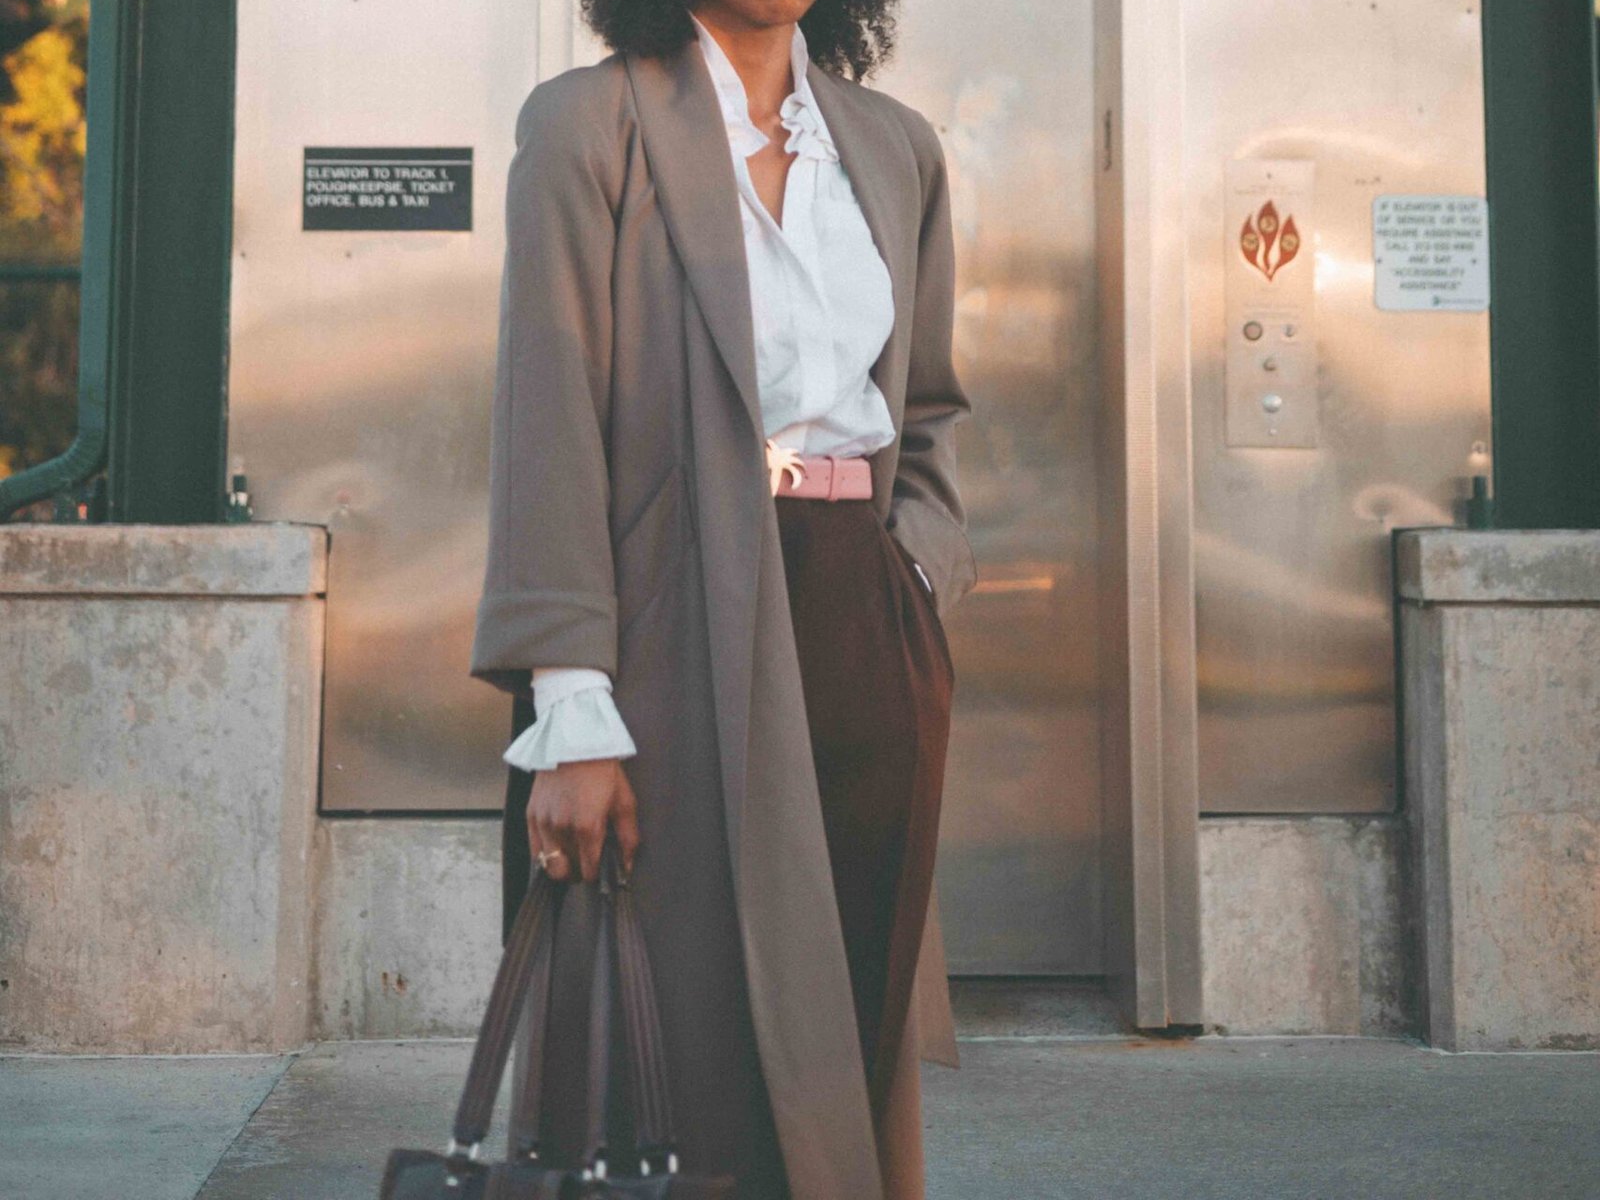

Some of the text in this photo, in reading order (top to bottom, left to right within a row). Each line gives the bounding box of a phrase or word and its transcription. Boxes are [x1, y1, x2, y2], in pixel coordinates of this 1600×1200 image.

[306, 167, 369, 179] ELEVATOR
[373, 167, 390, 179] TO
[394, 167, 436, 179] TRACK
[410, 181, 455, 193] TICKET
[358, 194, 385, 207] BUS
[388, 195, 398, 207] &
[401, 194, 430, 207] TAXI
